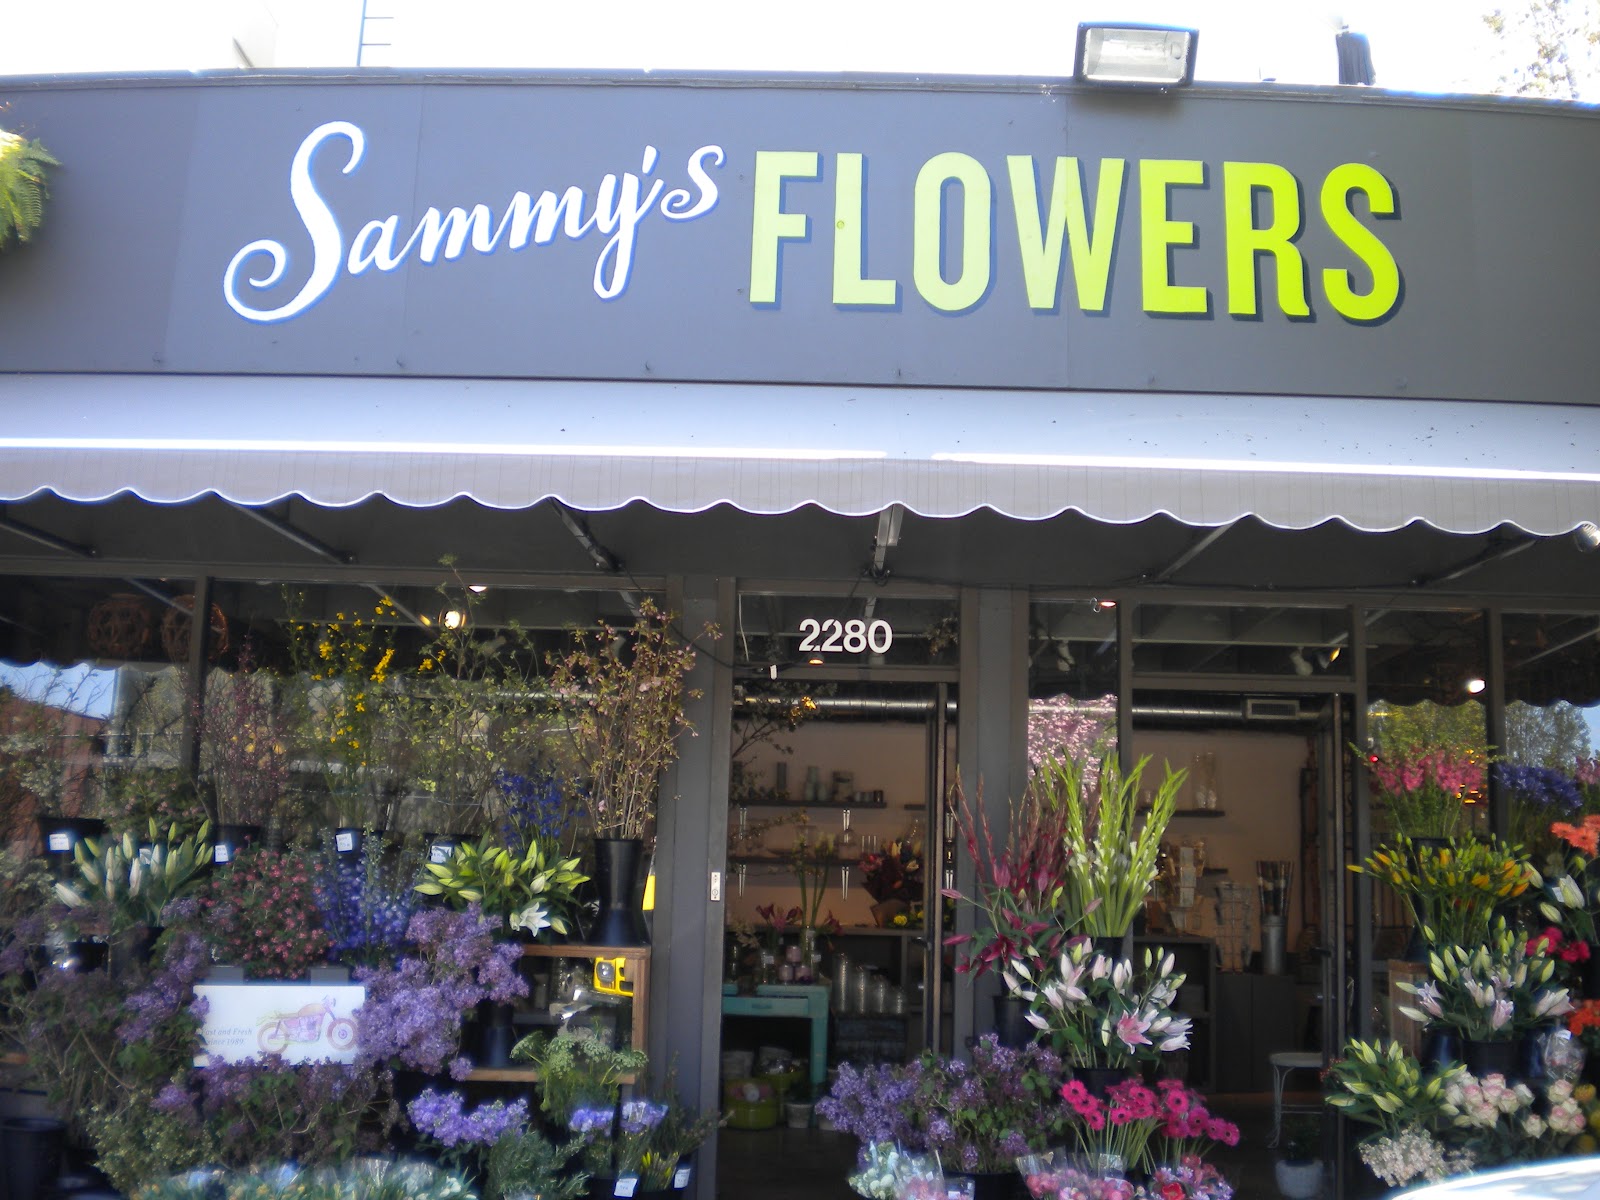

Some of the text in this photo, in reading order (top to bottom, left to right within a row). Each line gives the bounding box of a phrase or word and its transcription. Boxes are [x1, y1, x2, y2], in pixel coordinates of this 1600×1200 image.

[223, 120, 1402, 322] Sammy's FLOWERS
[798, 618, 893, 653] 2280
[217, 1027, 232, 1036] and
[232, 1027, 252, 1036] Fresh
